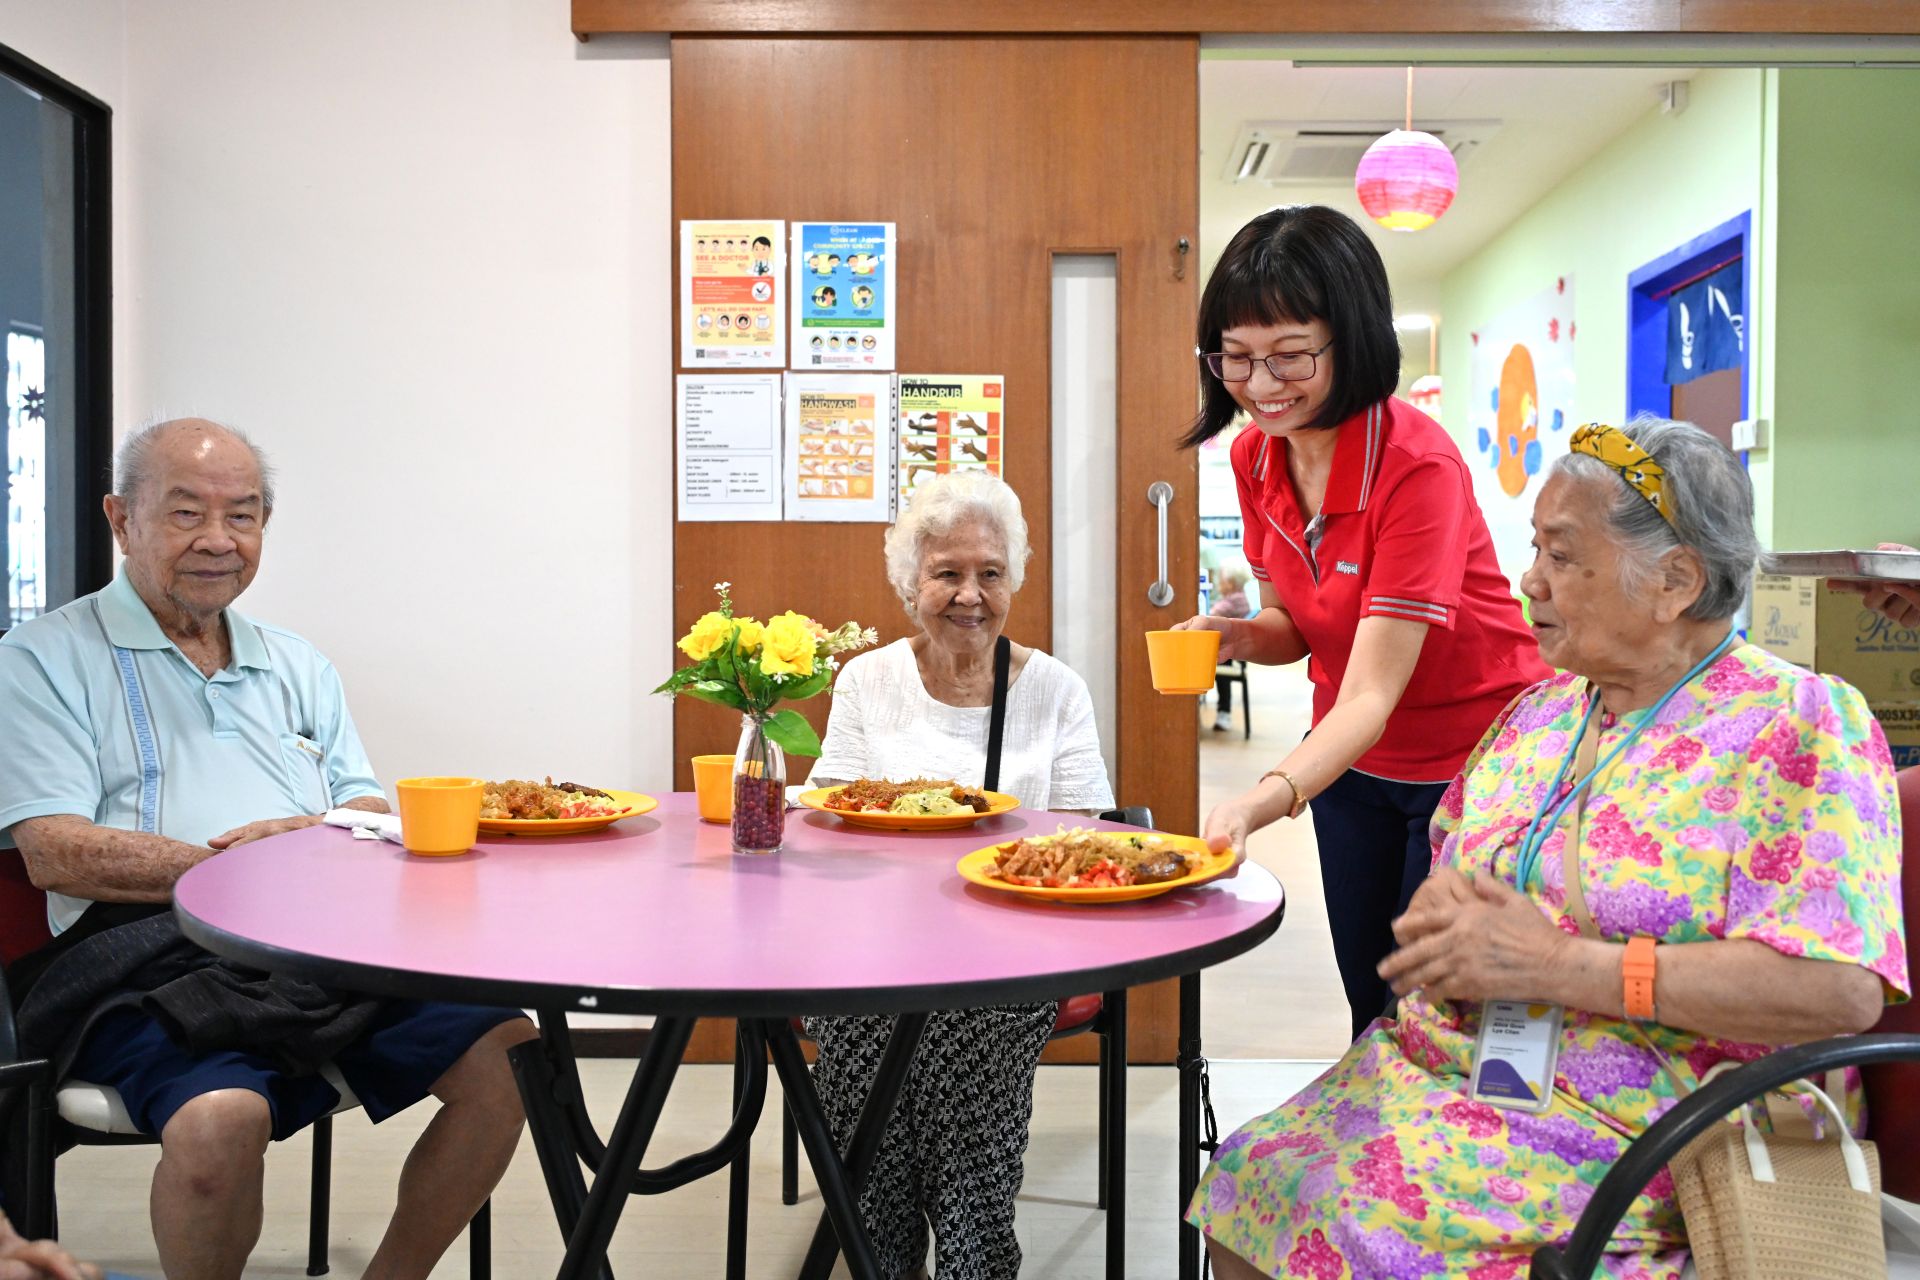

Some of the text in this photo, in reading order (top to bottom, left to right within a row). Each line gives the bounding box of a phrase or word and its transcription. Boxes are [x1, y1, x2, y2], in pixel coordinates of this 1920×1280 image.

[902, 387, 961, 398] HANDRUB
[801, 400, 856, 409] HANDWASH
[1336, 560, 1358, 575] Keppel
